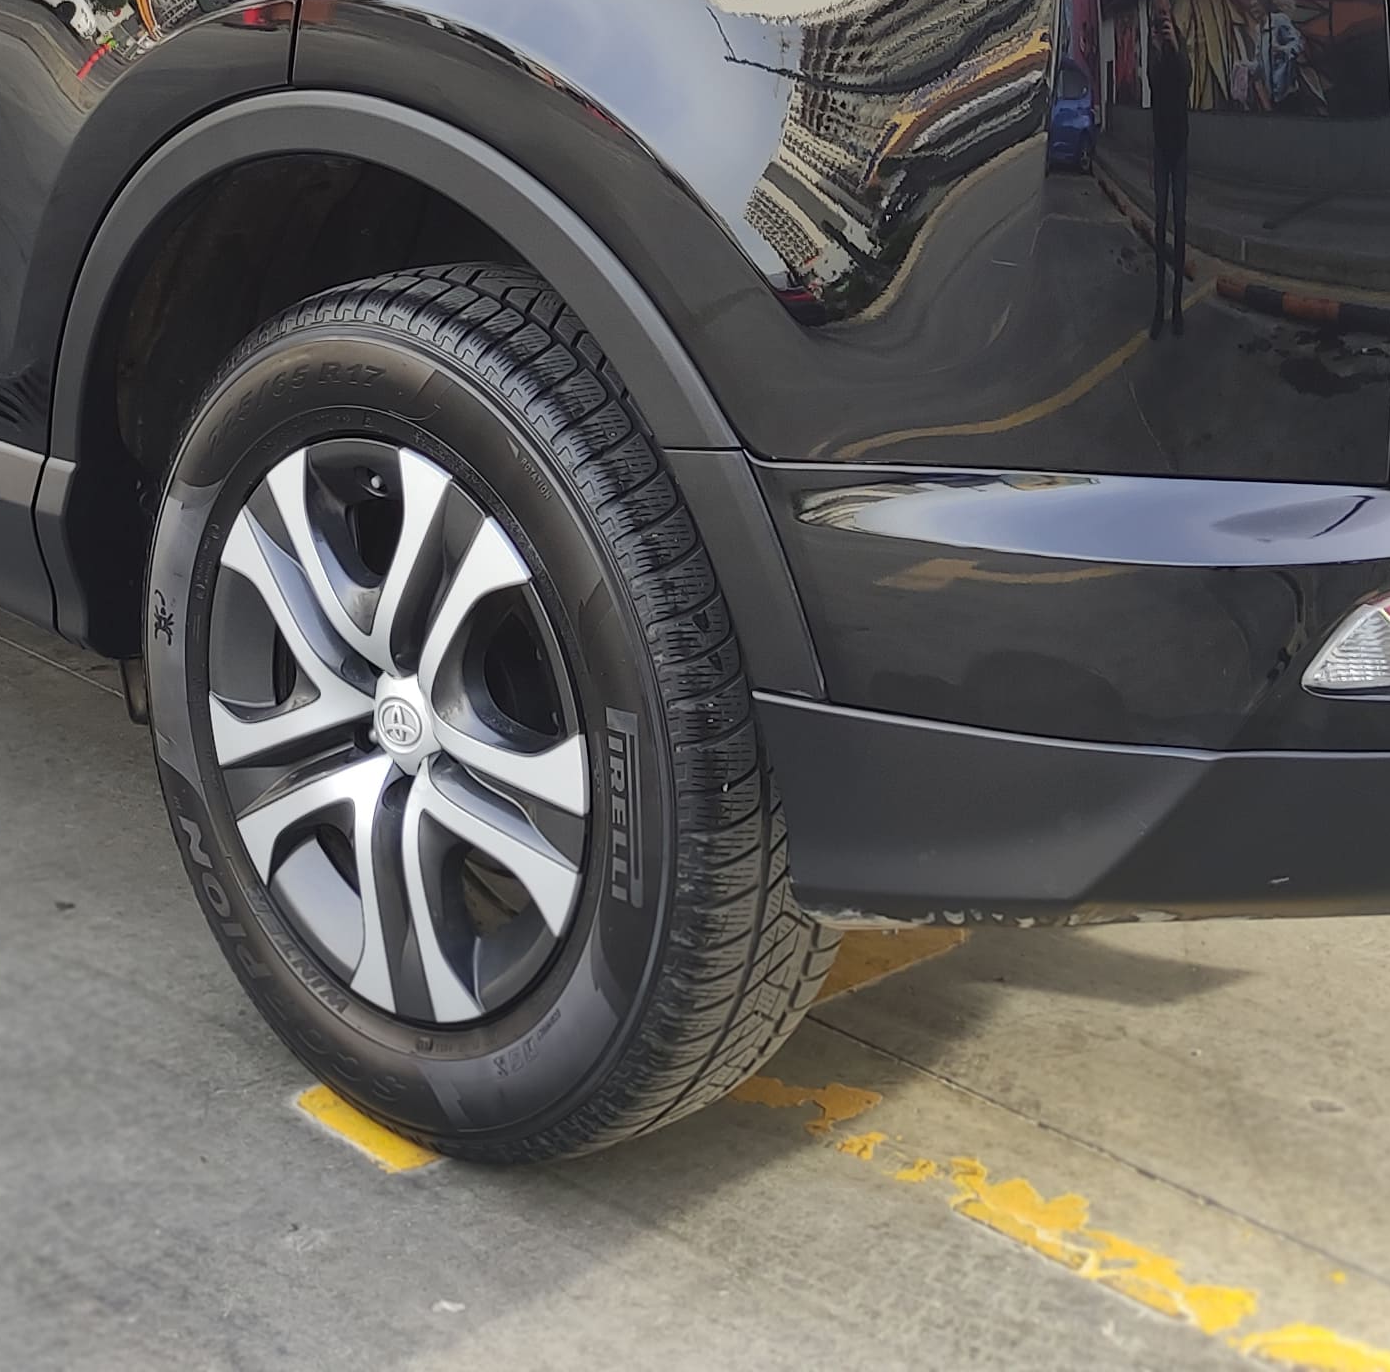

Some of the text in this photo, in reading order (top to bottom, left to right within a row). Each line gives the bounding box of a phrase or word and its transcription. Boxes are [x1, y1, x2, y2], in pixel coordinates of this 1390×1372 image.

[519, 456, 554, 502] ROTATION
[605, 706, 644, 909] PIRELLI
[177, 812, 408, 1102] SCORPION
